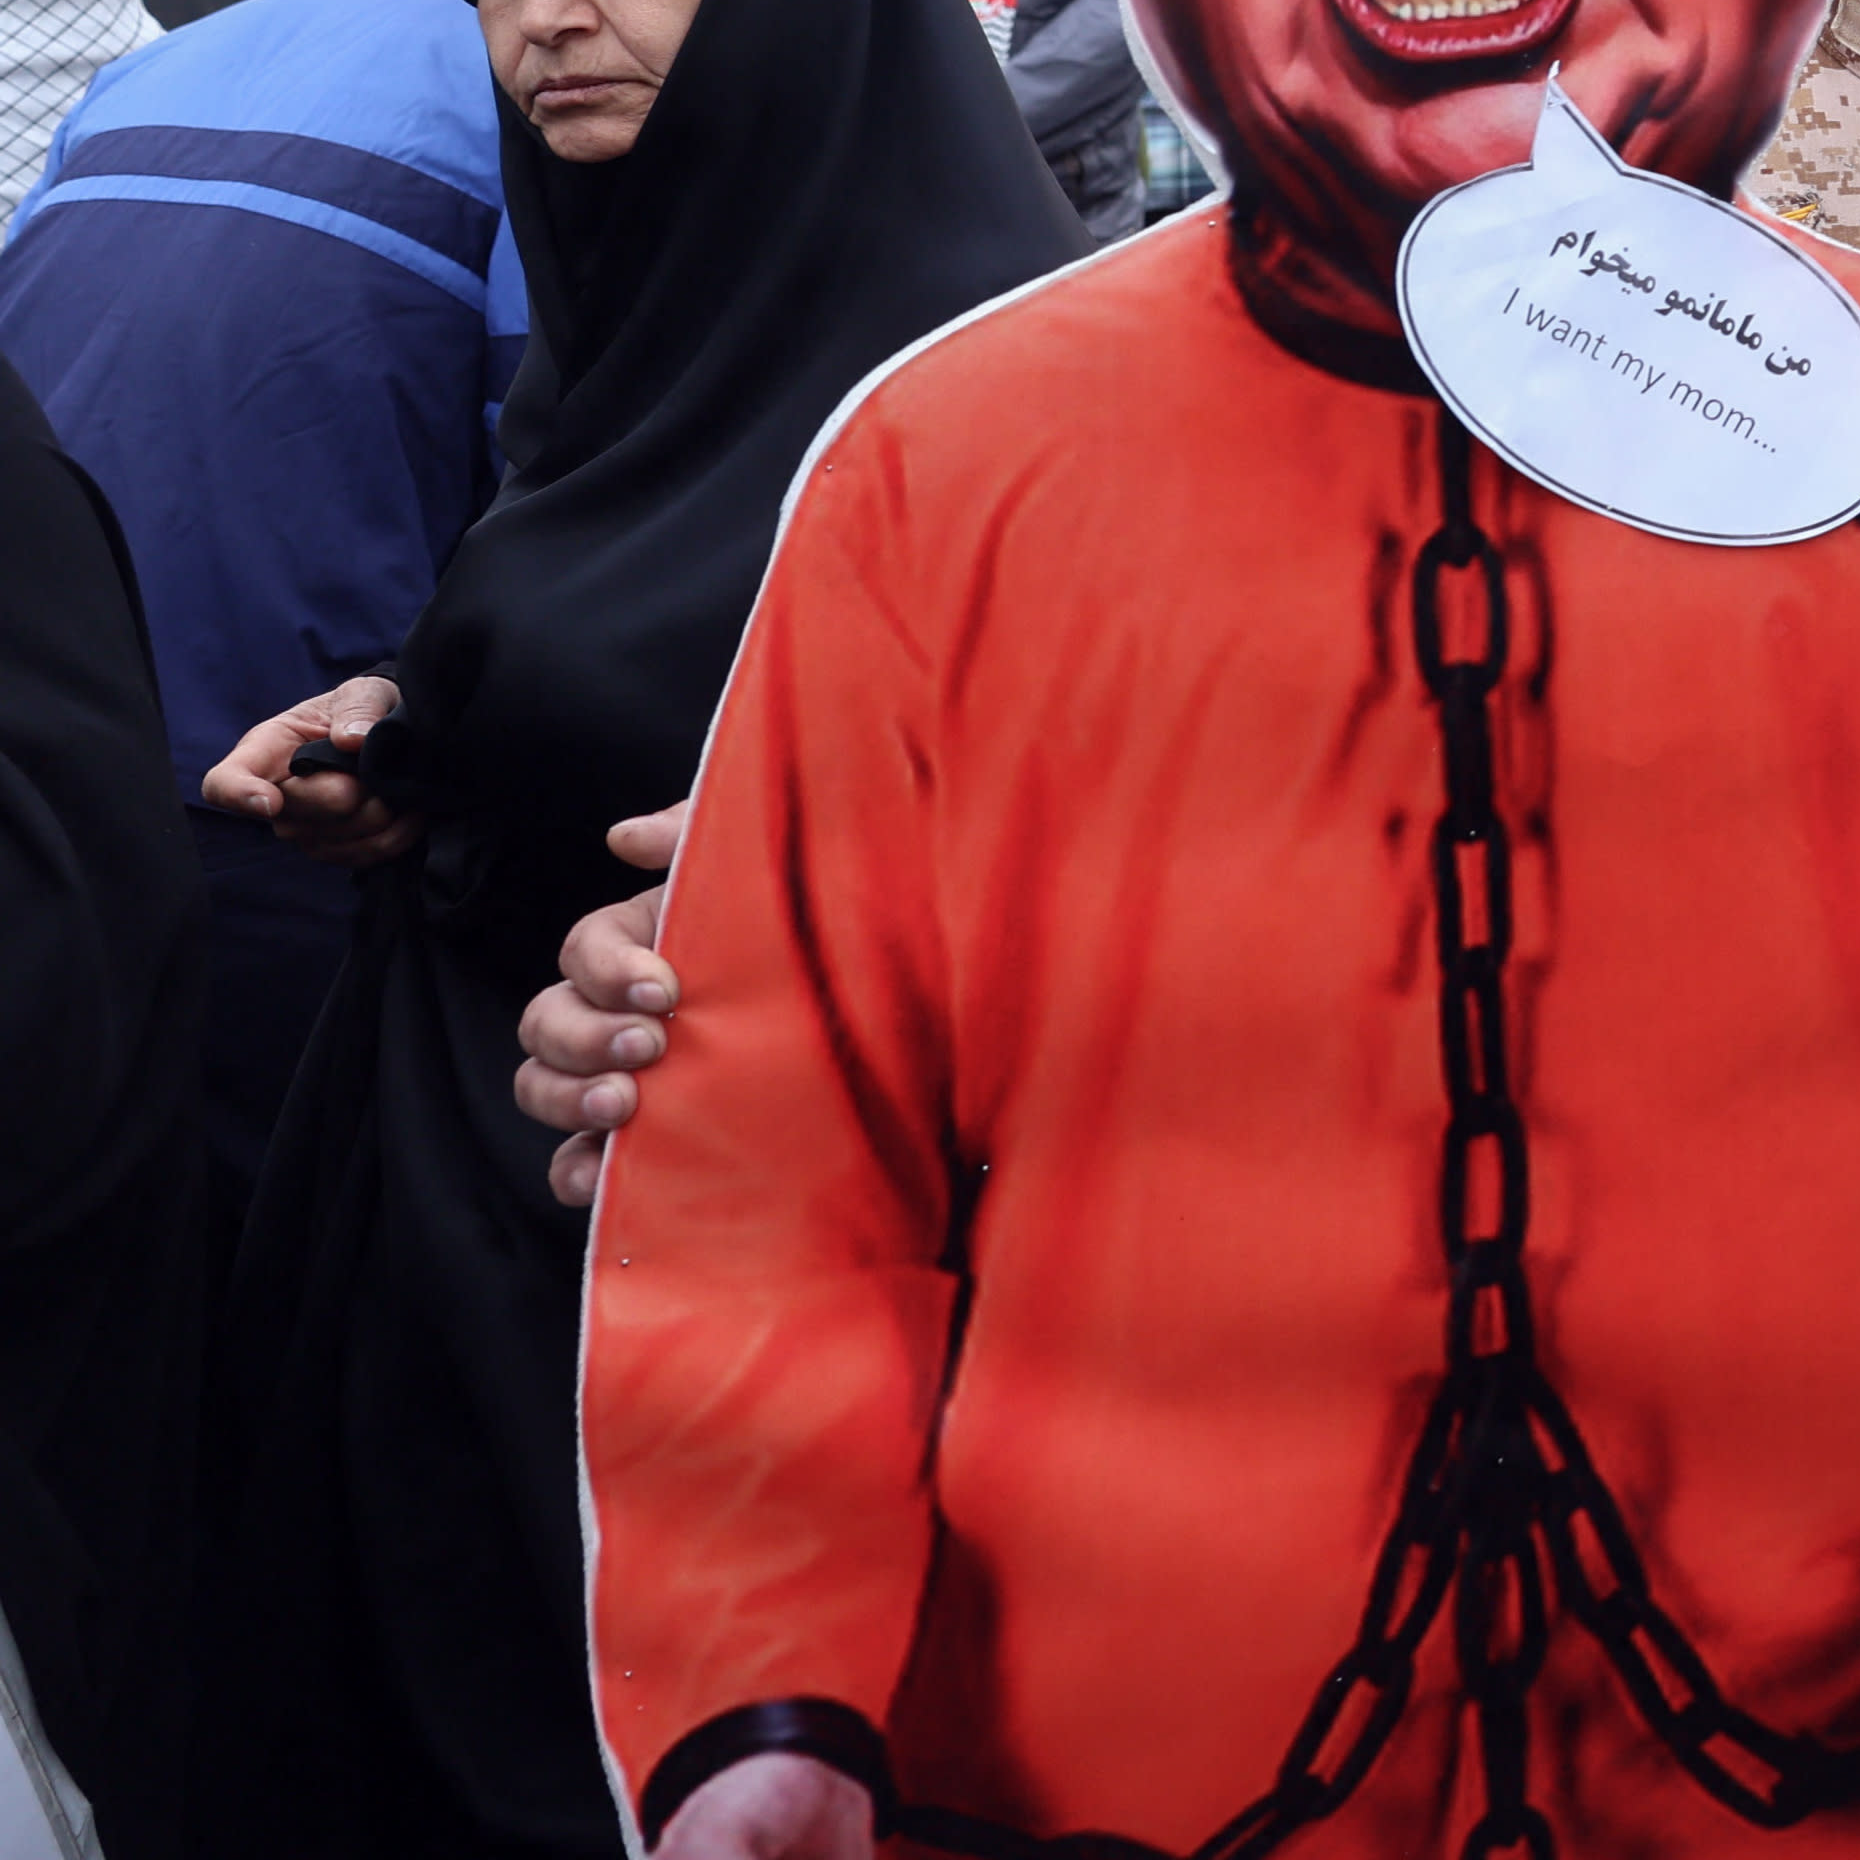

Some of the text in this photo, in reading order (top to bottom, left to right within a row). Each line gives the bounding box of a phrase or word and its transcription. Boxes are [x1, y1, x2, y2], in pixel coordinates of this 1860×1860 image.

[1502, 287, 1778, 454] I want my mom...
[1550, 228, 1814, 380] من مامانمو میخوام
